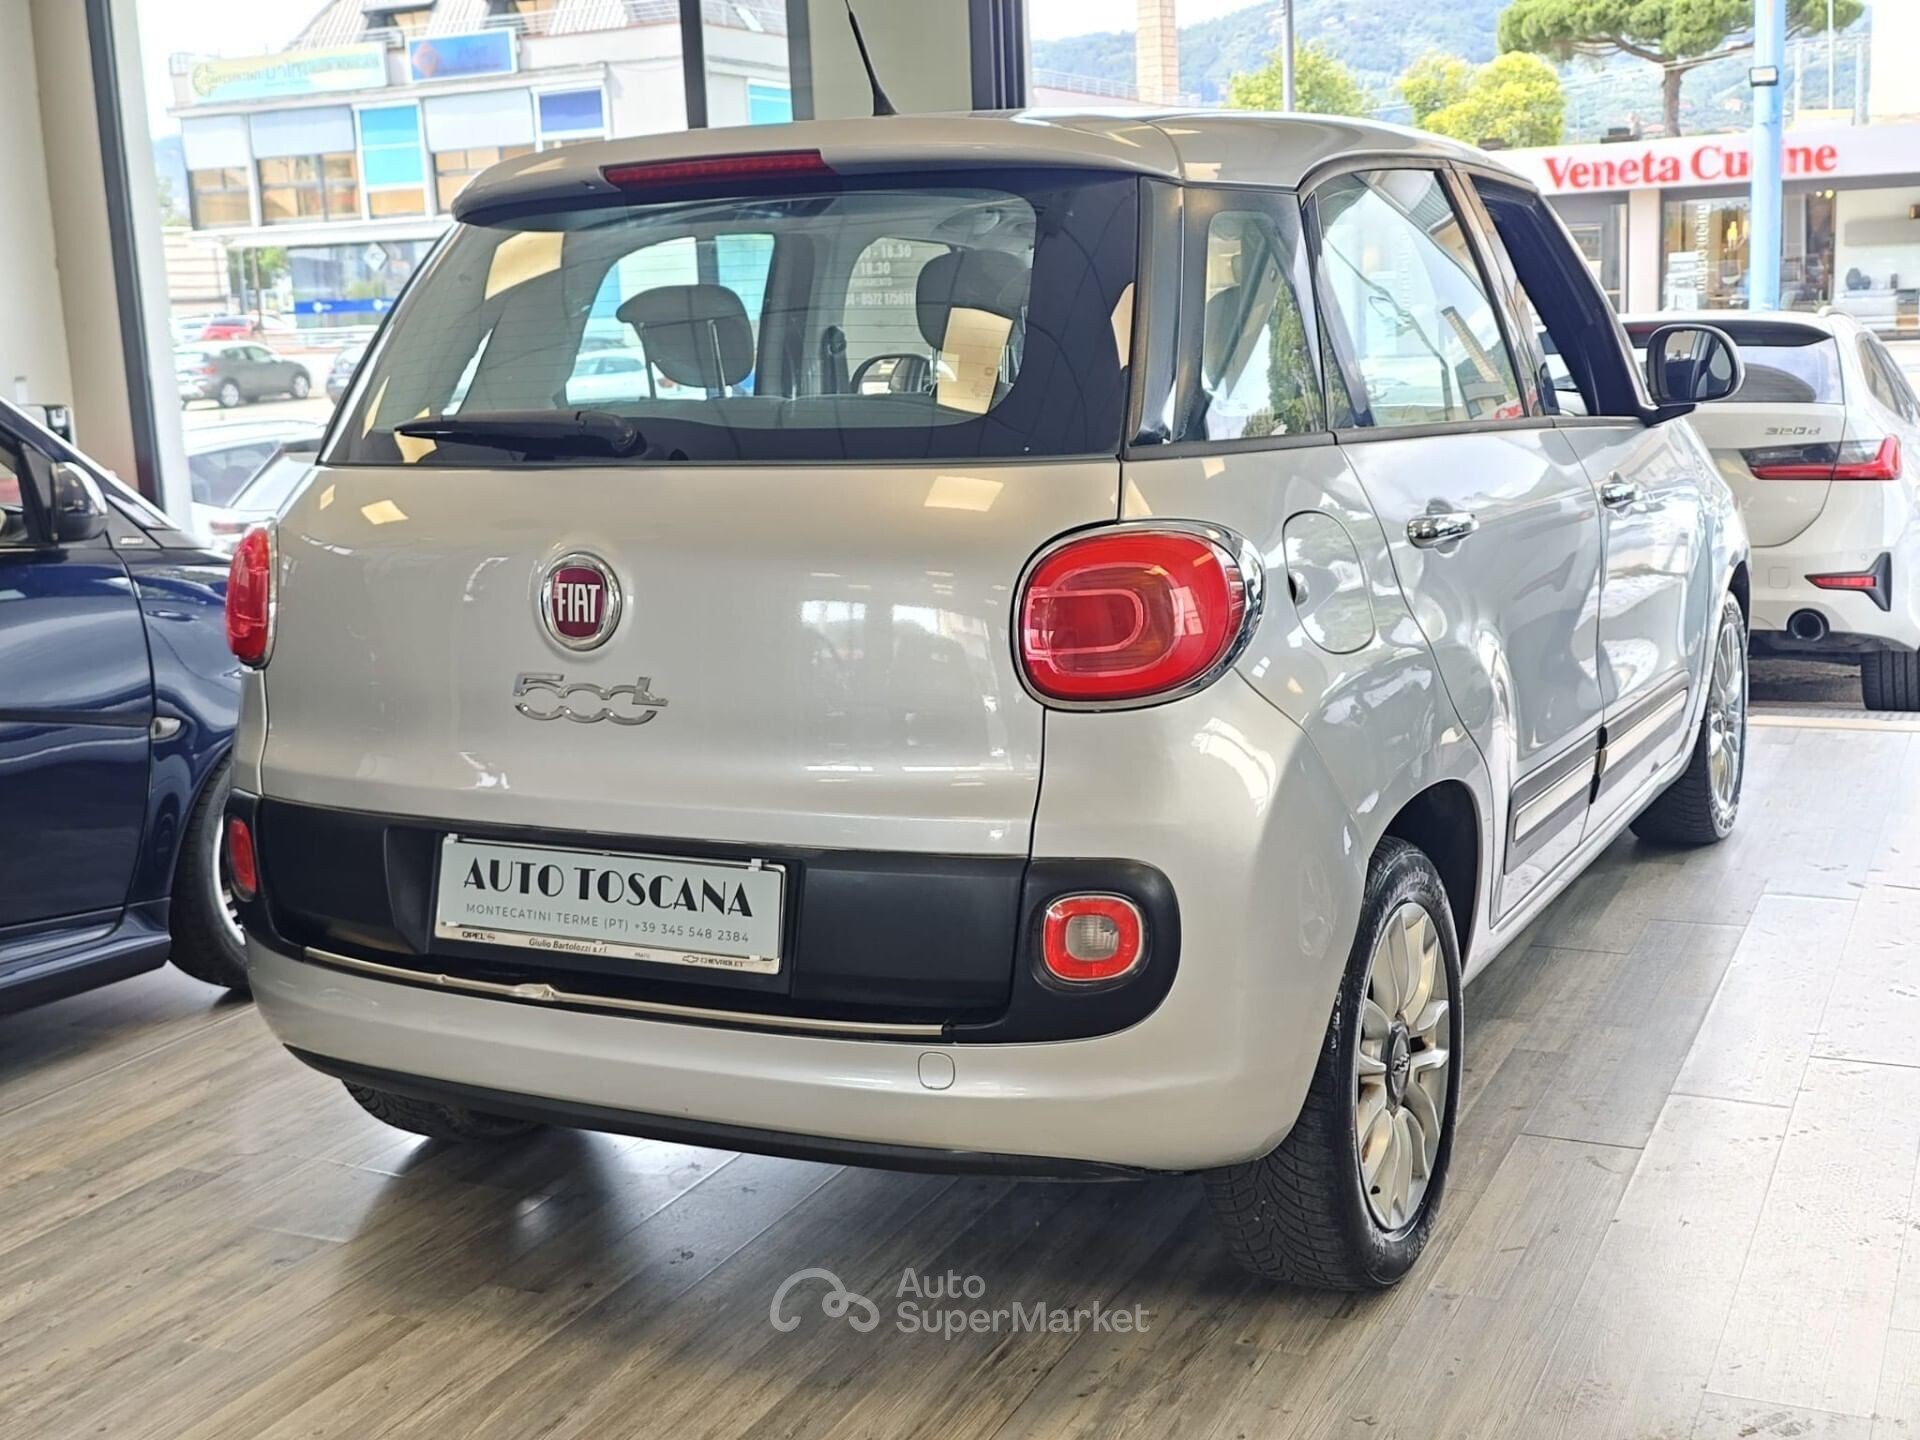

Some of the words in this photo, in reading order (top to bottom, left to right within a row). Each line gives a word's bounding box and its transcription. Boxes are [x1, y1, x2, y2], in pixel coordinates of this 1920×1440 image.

[1544, 150, 1681, 188] Veneta
[1690, 142, 1838, 182] Cune
[556, 582, 601, 624] FIAT
[463, 856, 565, 898] AUTO
[574, 867, 753, 917] TOSCANA
[462, 931, 486, 941] OPEL
[465, 902, 552, 922] MONTECATINI
[555, 911, 600, 928] TERME
[604, 917, 629, 933] (PT)
[634, 920, 657, 934] +39
[660, 923, 685, 937] 345
[687, 926, 713, 940] 548
[716, 929, 750, 943] 2384
[528, 937, 551, 949] Giulio
[553, 940, 591, 953] Bartolozzi
